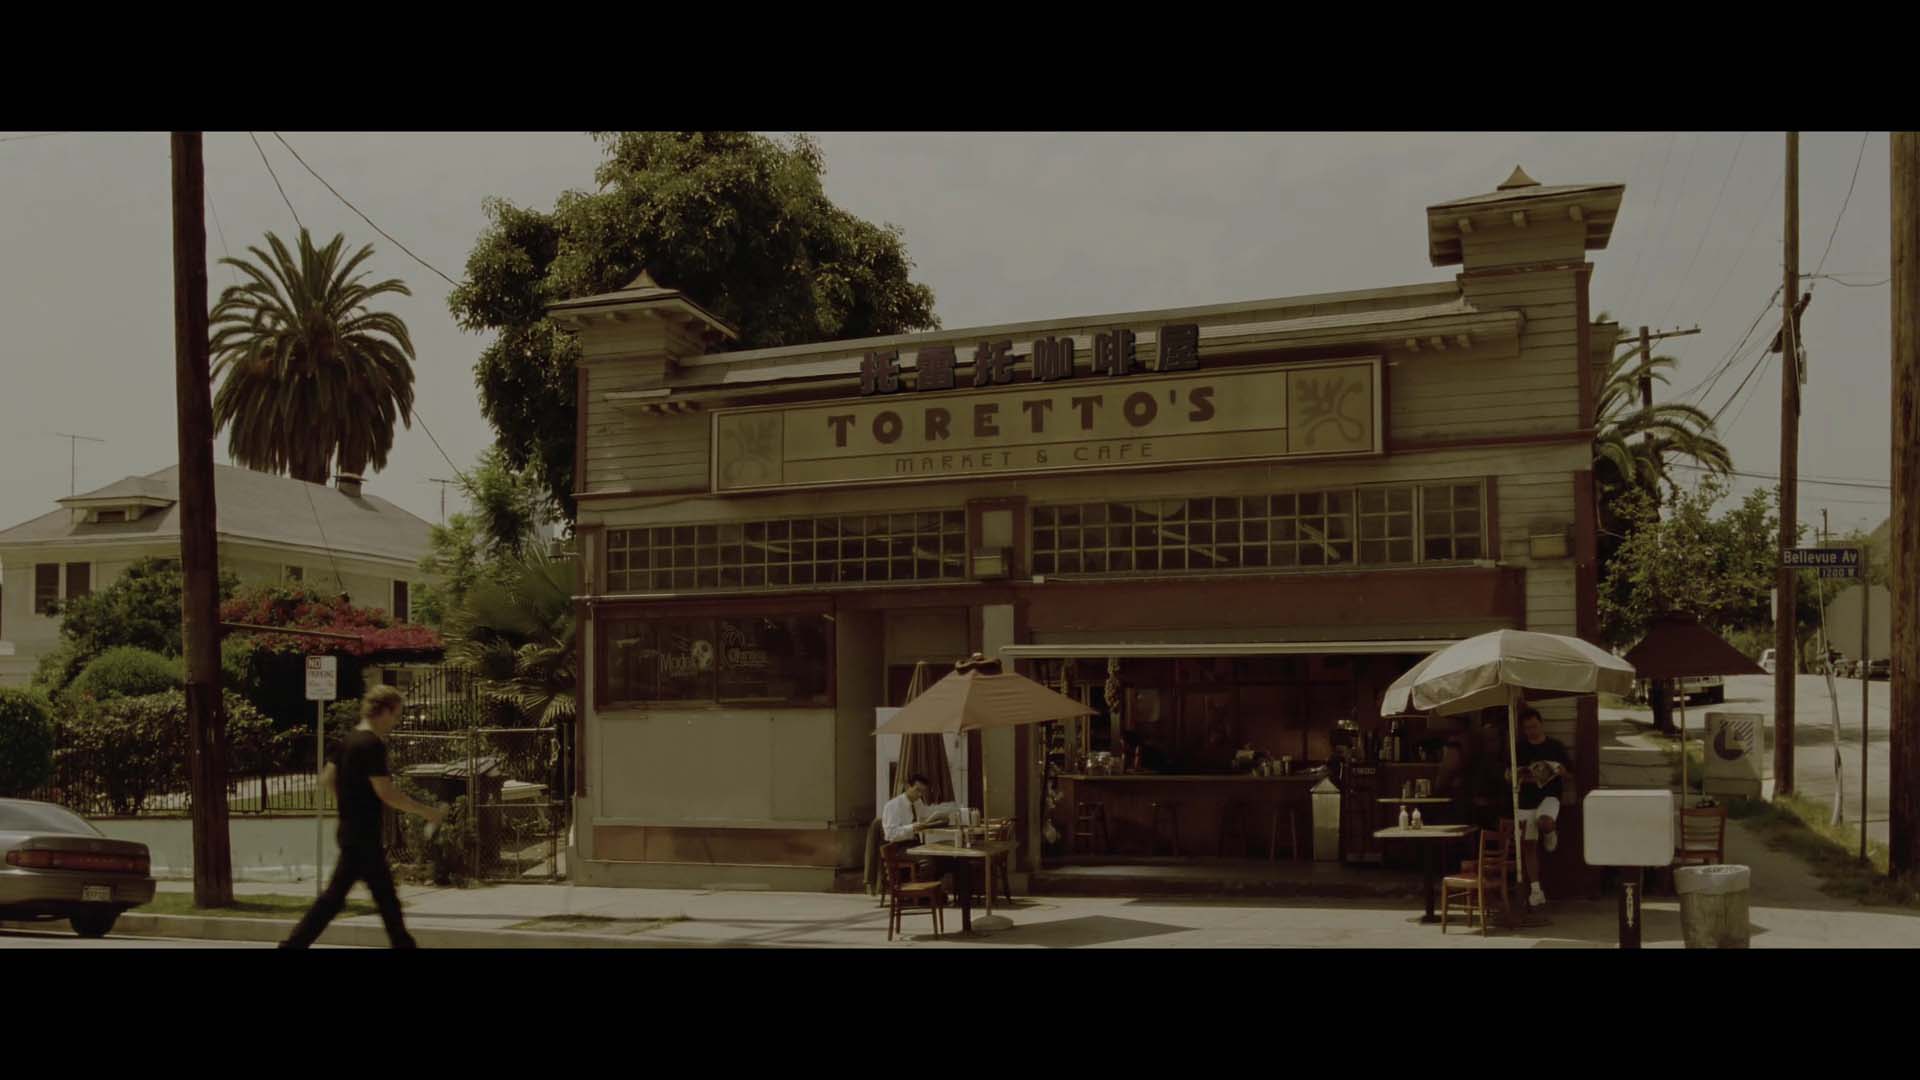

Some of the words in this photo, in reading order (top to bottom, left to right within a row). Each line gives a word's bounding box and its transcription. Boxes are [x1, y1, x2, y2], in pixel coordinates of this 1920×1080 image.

[828, 386, 1215, 447] TORETTO'S
[896, 451, 1011, 473] MARKET
[1036, 450, 1048, 463] &
[1073, 443, 1153, 462] CAFE
[1783, 550, 1837, 564] Bellevue
[1842, 549, 1857, 564] Av
[309, 658, 321, 669] NO
